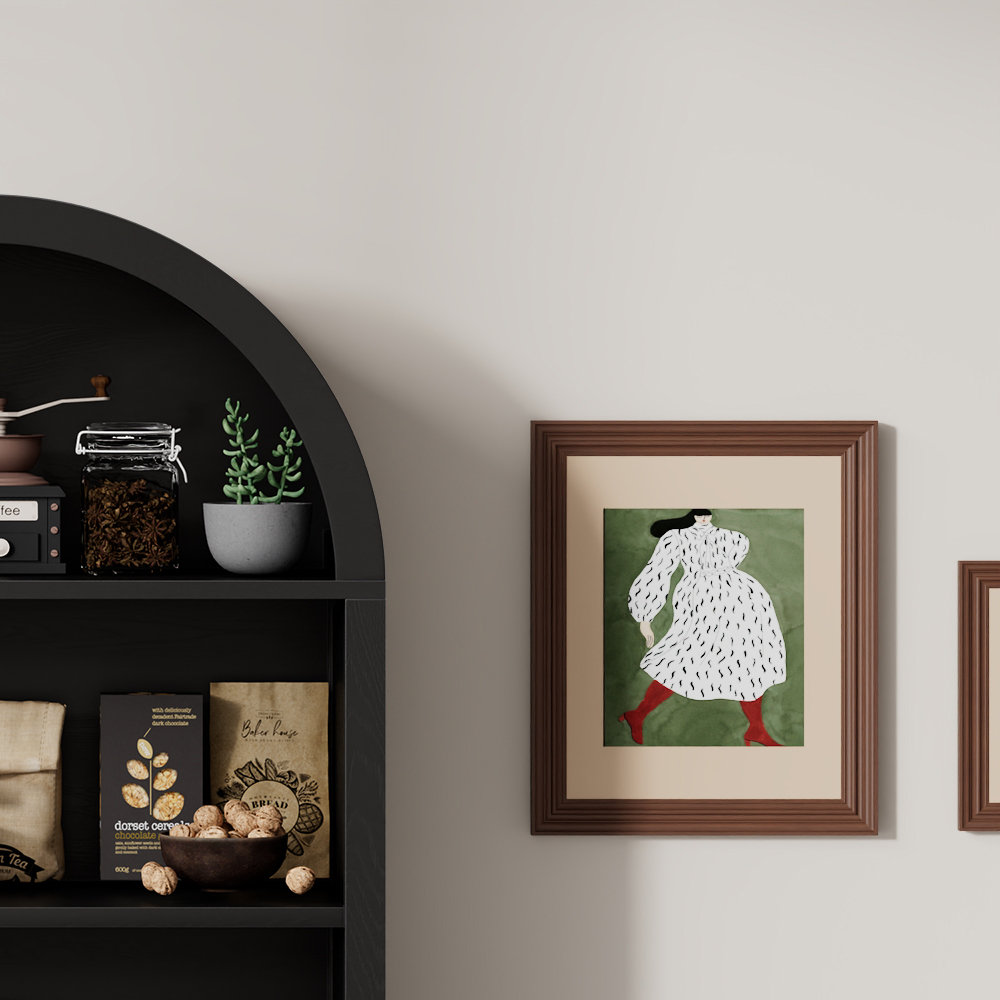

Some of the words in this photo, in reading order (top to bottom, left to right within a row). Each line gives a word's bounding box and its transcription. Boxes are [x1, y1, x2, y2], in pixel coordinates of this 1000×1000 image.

[114, 820, 150, 831] dorset
[114, 831, 157, 840] chocolate
[9, 853, 28, 869] Tea
[114, 866, 130, 874] 600g
